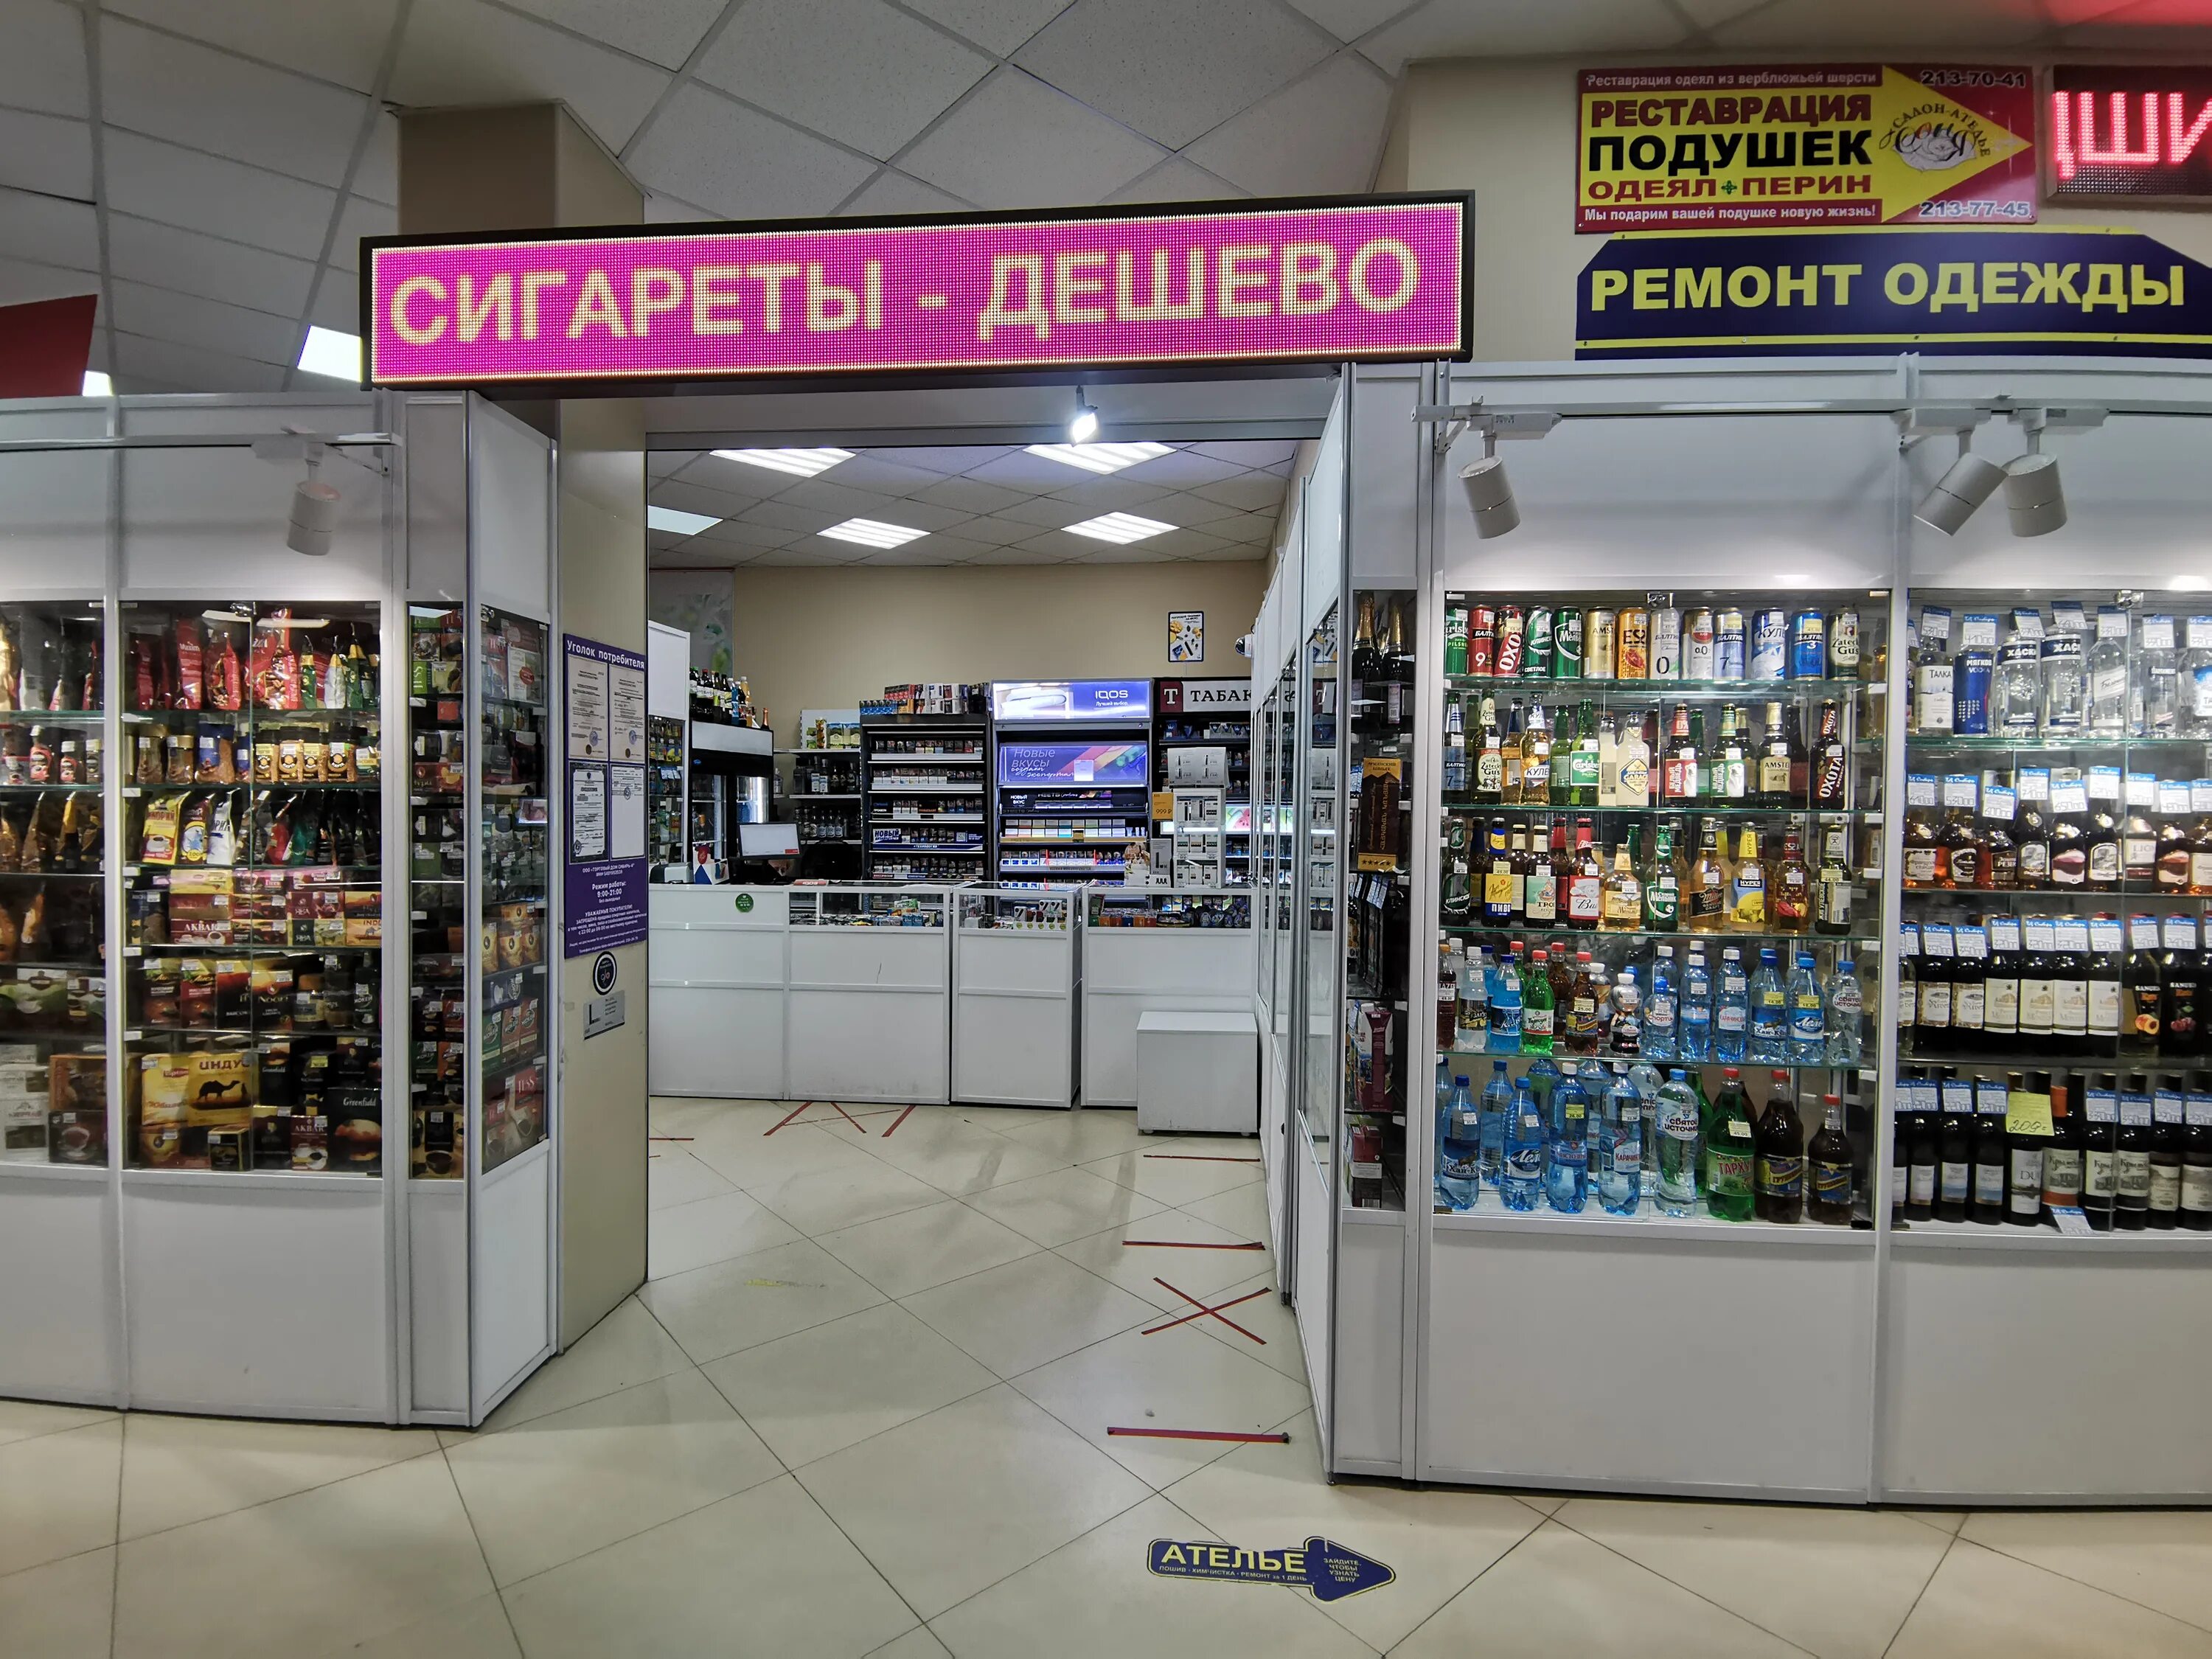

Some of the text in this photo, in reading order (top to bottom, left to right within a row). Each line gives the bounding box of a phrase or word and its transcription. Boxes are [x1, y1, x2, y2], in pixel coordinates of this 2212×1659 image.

[1587, 72, 1876, 87] Реставрация одеял из верблюжьей шерсти
[1921, 70, 2026, 87] 213-70-41
[1591, 94, 1871, 127] РЕСТАВРАЦИЯ
[1588, 130, 1873, 176] ПОДУШЕК
[1588, 175, 1871, 202] ОДЕЯЛ ПЕРИН
[1585, 208, 1606, 220] Мы
[1610, 209, 1668, 222] подарим
[1672, 206, 1714, 220] вашей
[1719, 207, 1776, 221] подушке
[1781, 207, 1823, 220] новую
[1919, 200, 2029, 217] 213-77-45
[390, 259, 885, 345] СИГАРЕТЫ
[977, 237, 1420, 343] ДЕШЕВО
[1591, 262, 2184, 313] РЕМОНТ ОДЕЖДЫ
[567, 639, 645, 669] Уголок потребителя
[1095, 689, 1129, 699] IQOS
[1014, 748, 1056, 758] Новые
[1012, 759, 1050, 770] вкусы
[597, 888, 622, 897] 9:00-21:00
[1161, 1545, 1307, 1573] АТЕЛЬЕ
[1241, 1571, 1270, 1579] РЕМОНТ
[1329, 1564, 1358, 1572] ЧТОБЫ
[1329, 1570, 1360, 1578] УЗНАТЬ
